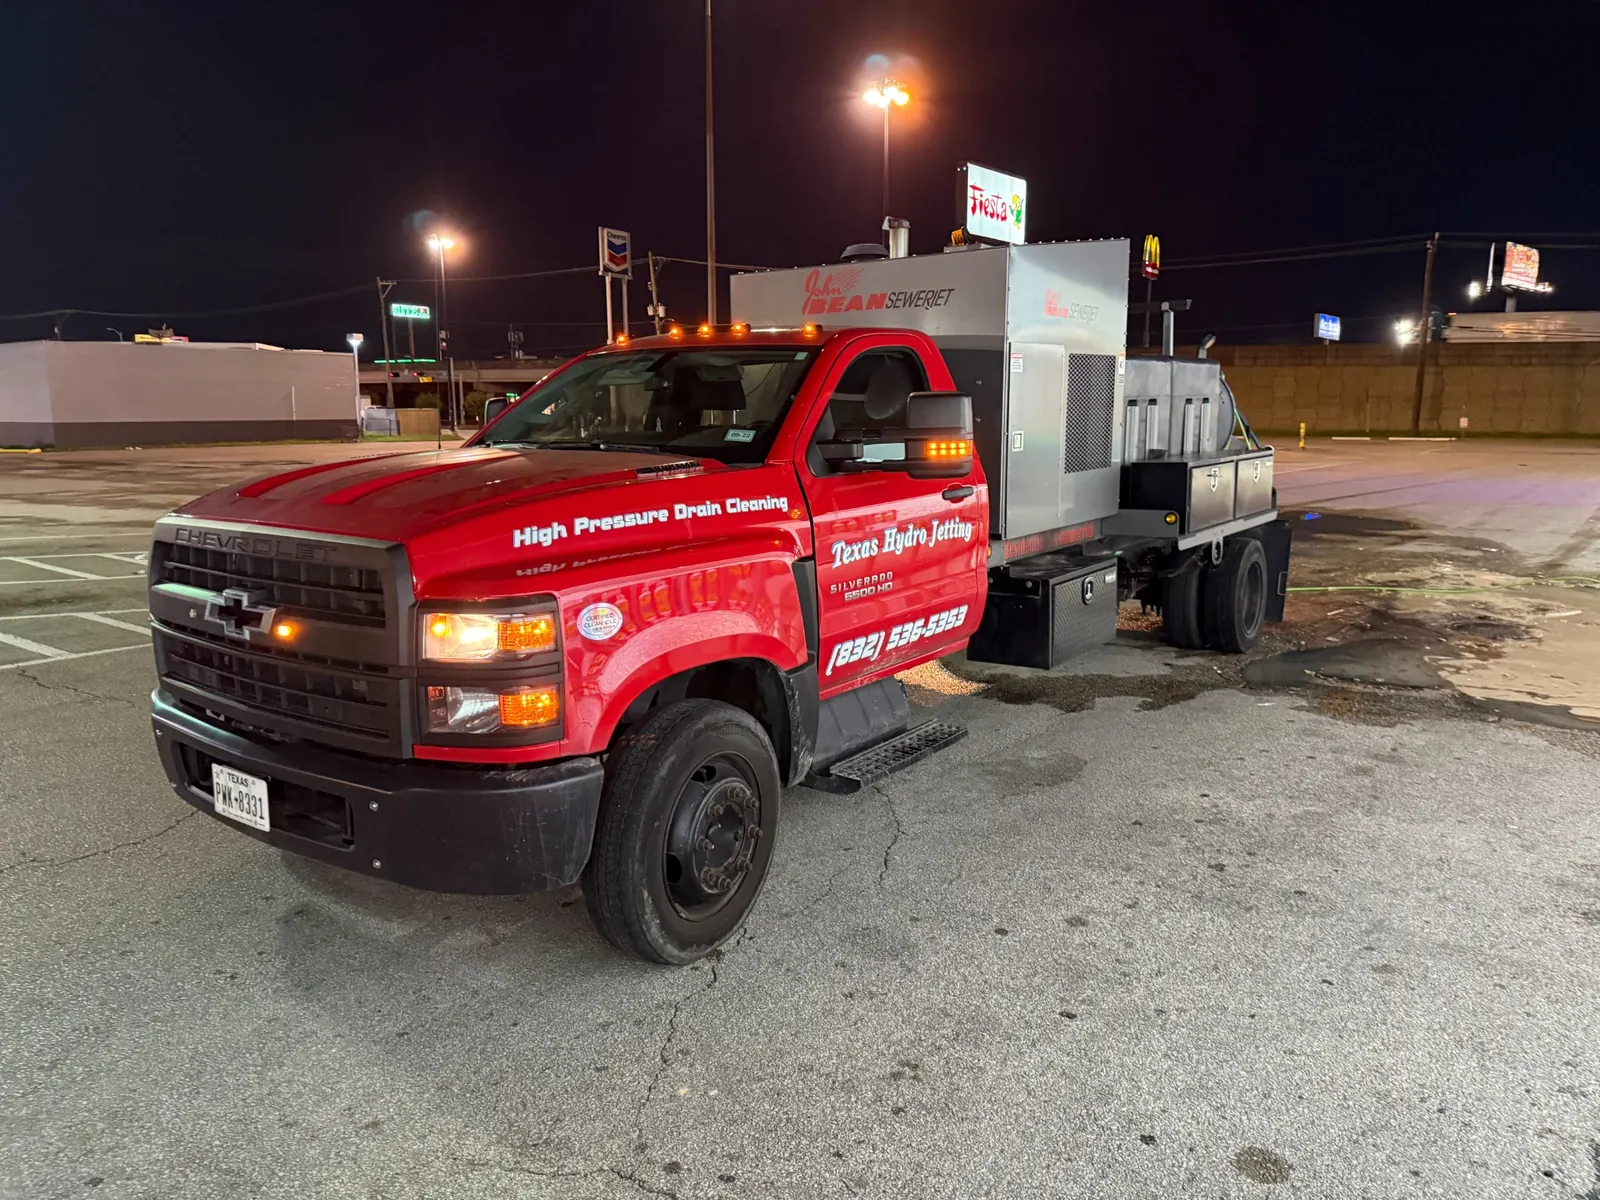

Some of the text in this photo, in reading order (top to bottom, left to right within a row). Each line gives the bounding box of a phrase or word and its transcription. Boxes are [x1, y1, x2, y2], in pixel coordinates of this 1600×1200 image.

[969, 183, 1007, 222] Fiesta
[801, 268, 842, 314] John
[807, 288, 955, 315] BEAN SEWERJET
[513, 495, 788, 548] High Pressure Drain Cleaning
[175, 528, 338, 562] CHEVROLET
[831, 516, 973, 569] Texas Hydro Jetting
[830, 571, 893, 593] SILVERADO
[877, 582, 893, 594] HD
[825, 604, 969, 677] (832) 536-5353
[227, 772, 249, 788] TEXAS
